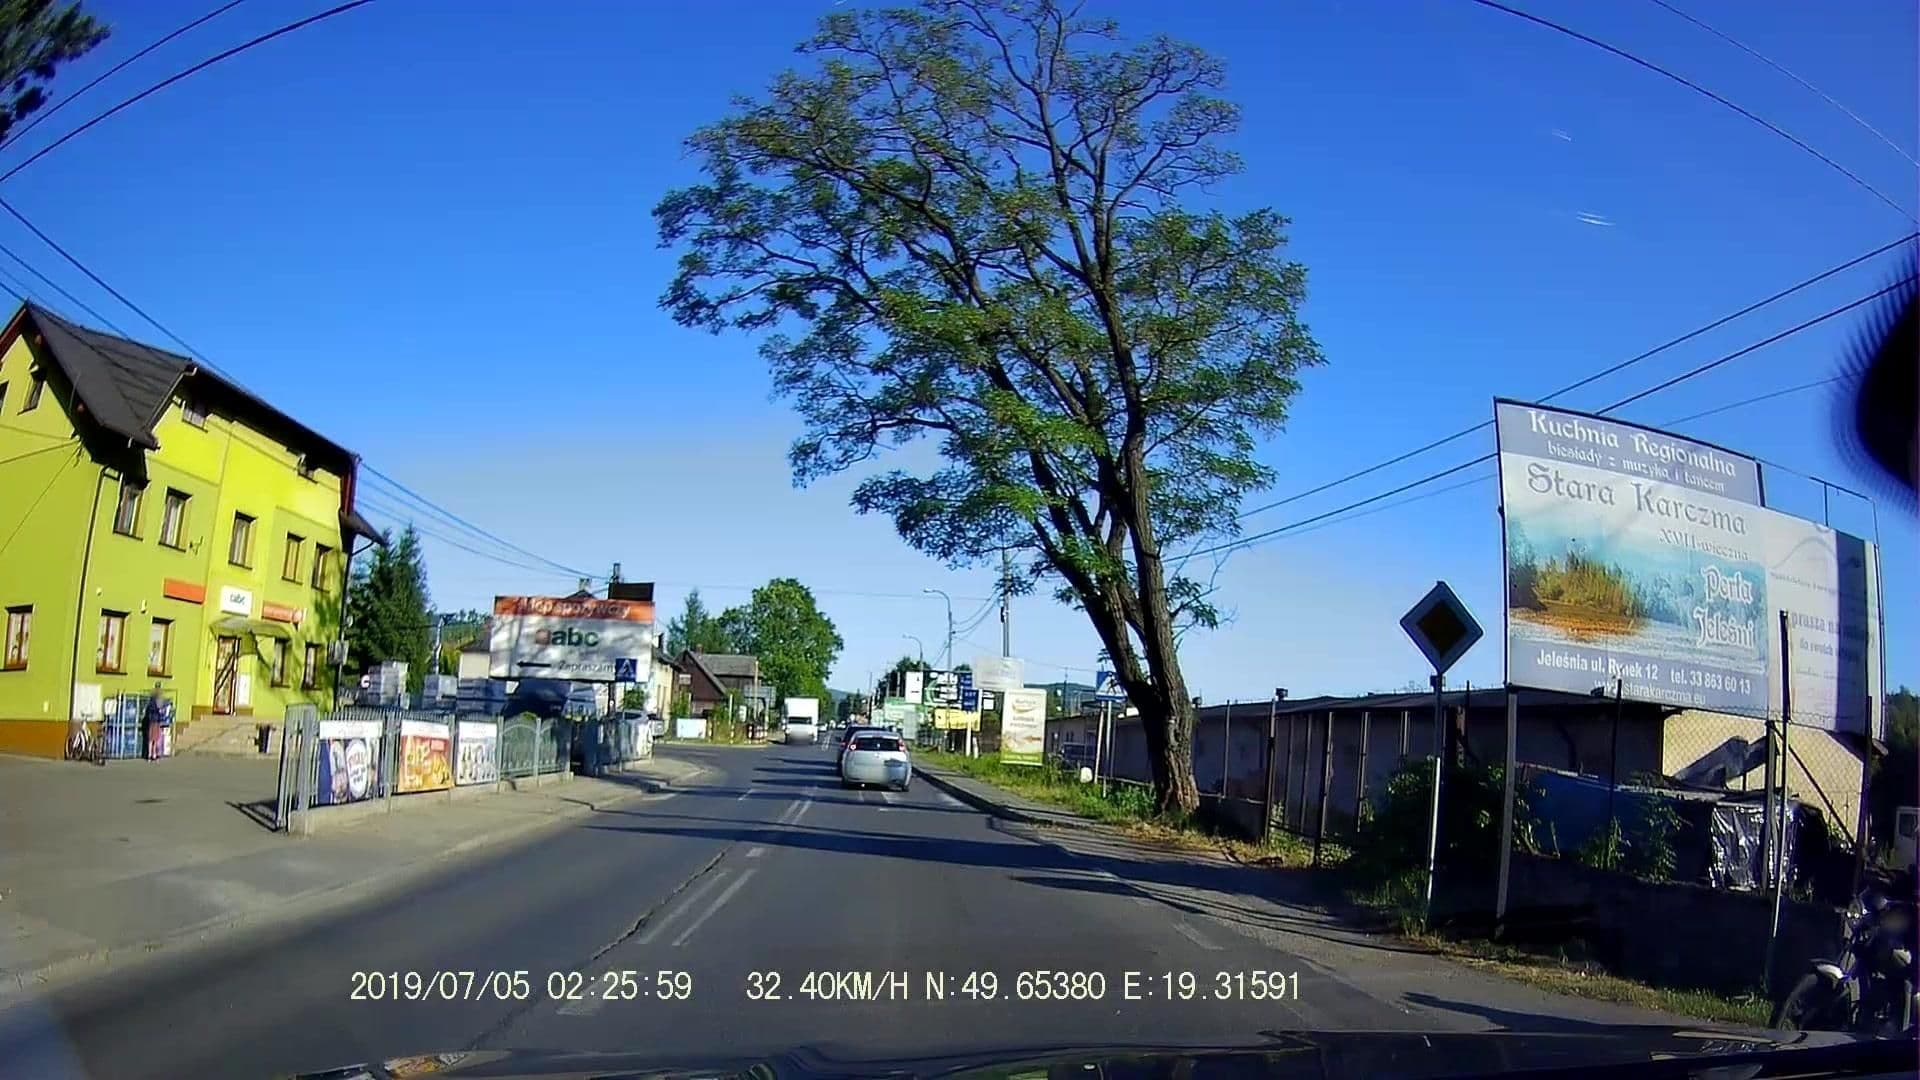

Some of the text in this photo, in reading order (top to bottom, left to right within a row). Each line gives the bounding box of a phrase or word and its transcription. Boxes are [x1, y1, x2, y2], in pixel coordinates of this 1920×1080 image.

[1528, 410, 1736, 478] Kuchnia Regionalna
[1527, 462, 1748, 536] Stara Karczma
[551, 627, 599, 647] abc
[1536, 648, 1751, 696] Jeleśnia ul. Rynek 12 tel. 33 863 60 13
